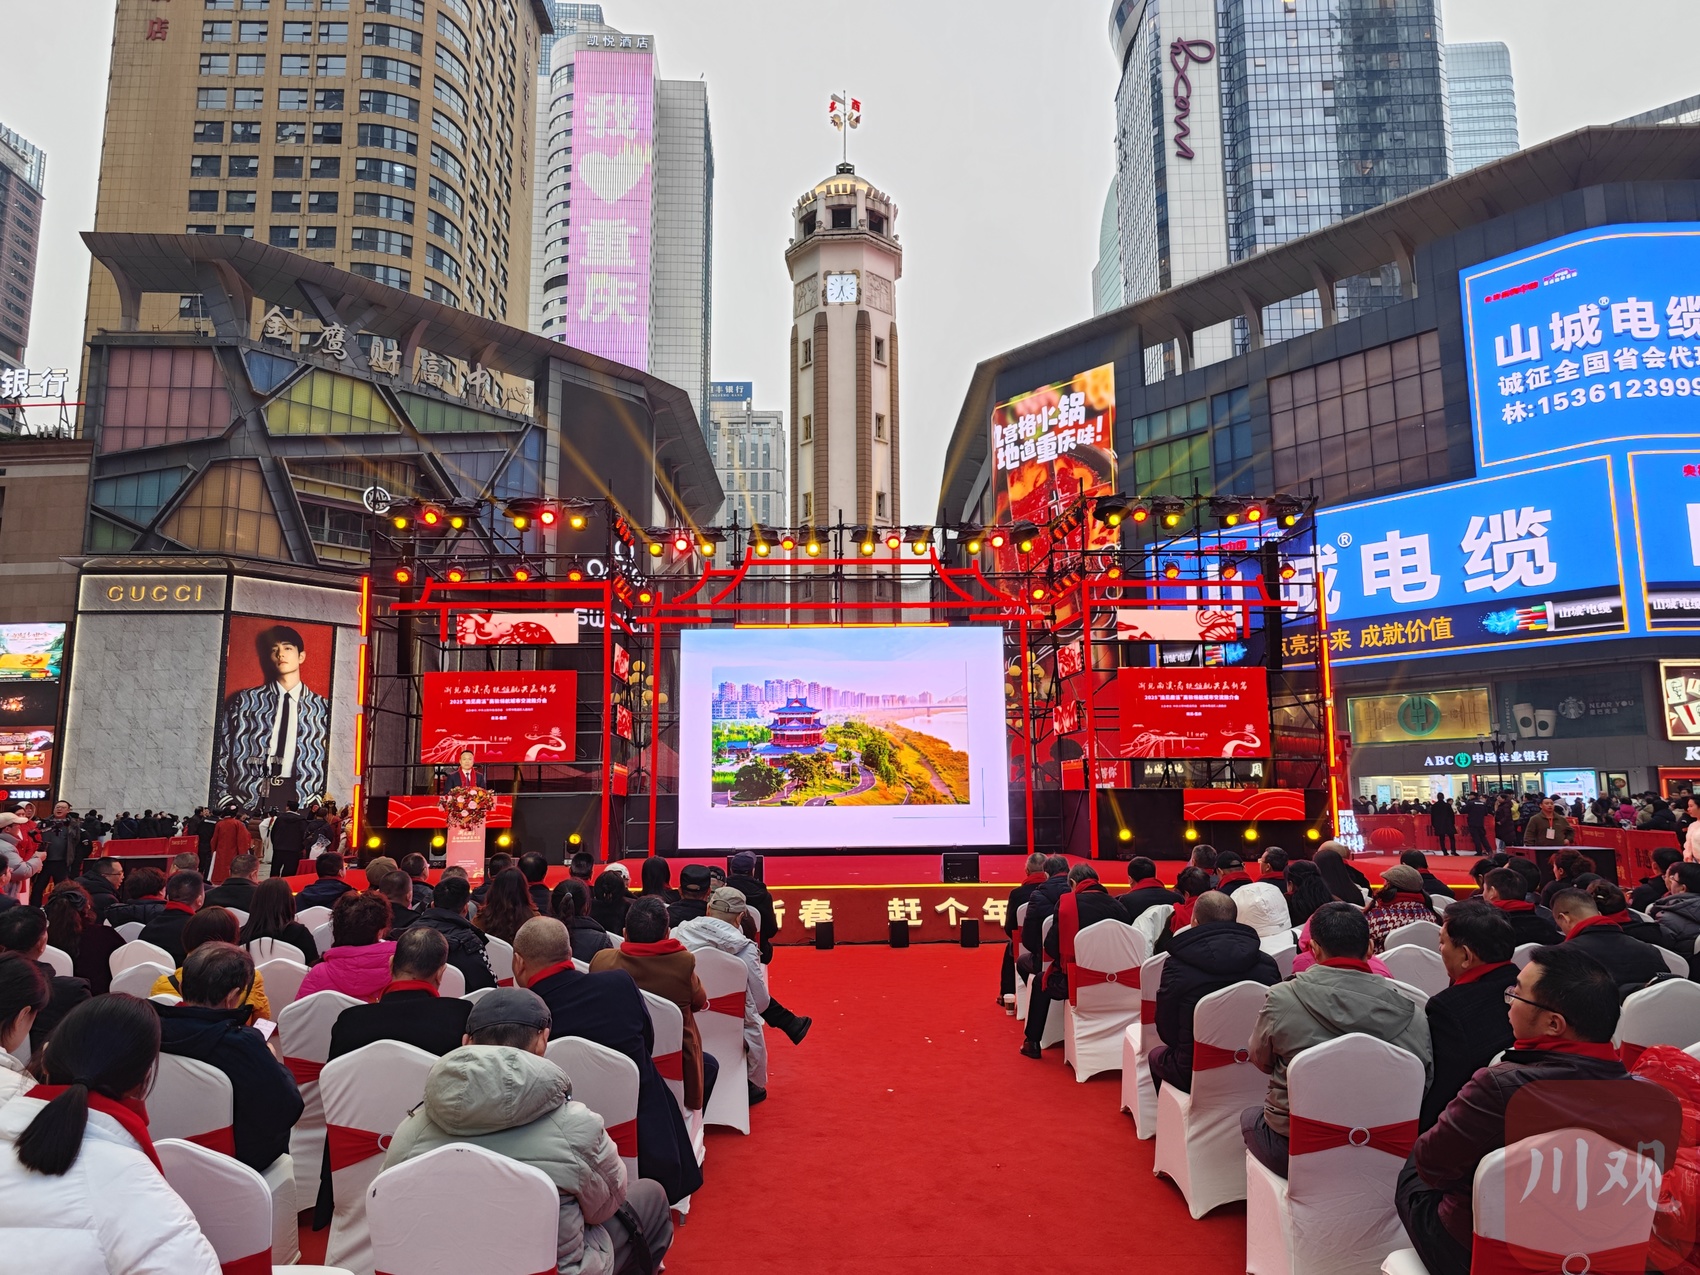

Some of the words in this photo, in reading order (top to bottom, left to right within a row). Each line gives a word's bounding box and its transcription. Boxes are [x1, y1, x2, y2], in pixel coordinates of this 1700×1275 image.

[586, 35, 650, 49] 凯悦酒店
[584, 92, 638, 140] 我
[577, 217, 639, 324] 重庆
[256, 304, 535, 405] 金鹰财富中心
[1, 366, 69, 399] 银行
[1497, 346, 1700, 397] 诚征全国省会代
[107, 584, 203, 602] GUCCI
[1359, 616, 1455, 649] 成就价值
[1424, 755, 1454, 766] ABC
[1472, 750, 1549, 764] 中国农业银行
[888, 896, 1009, 927] 赶个年
